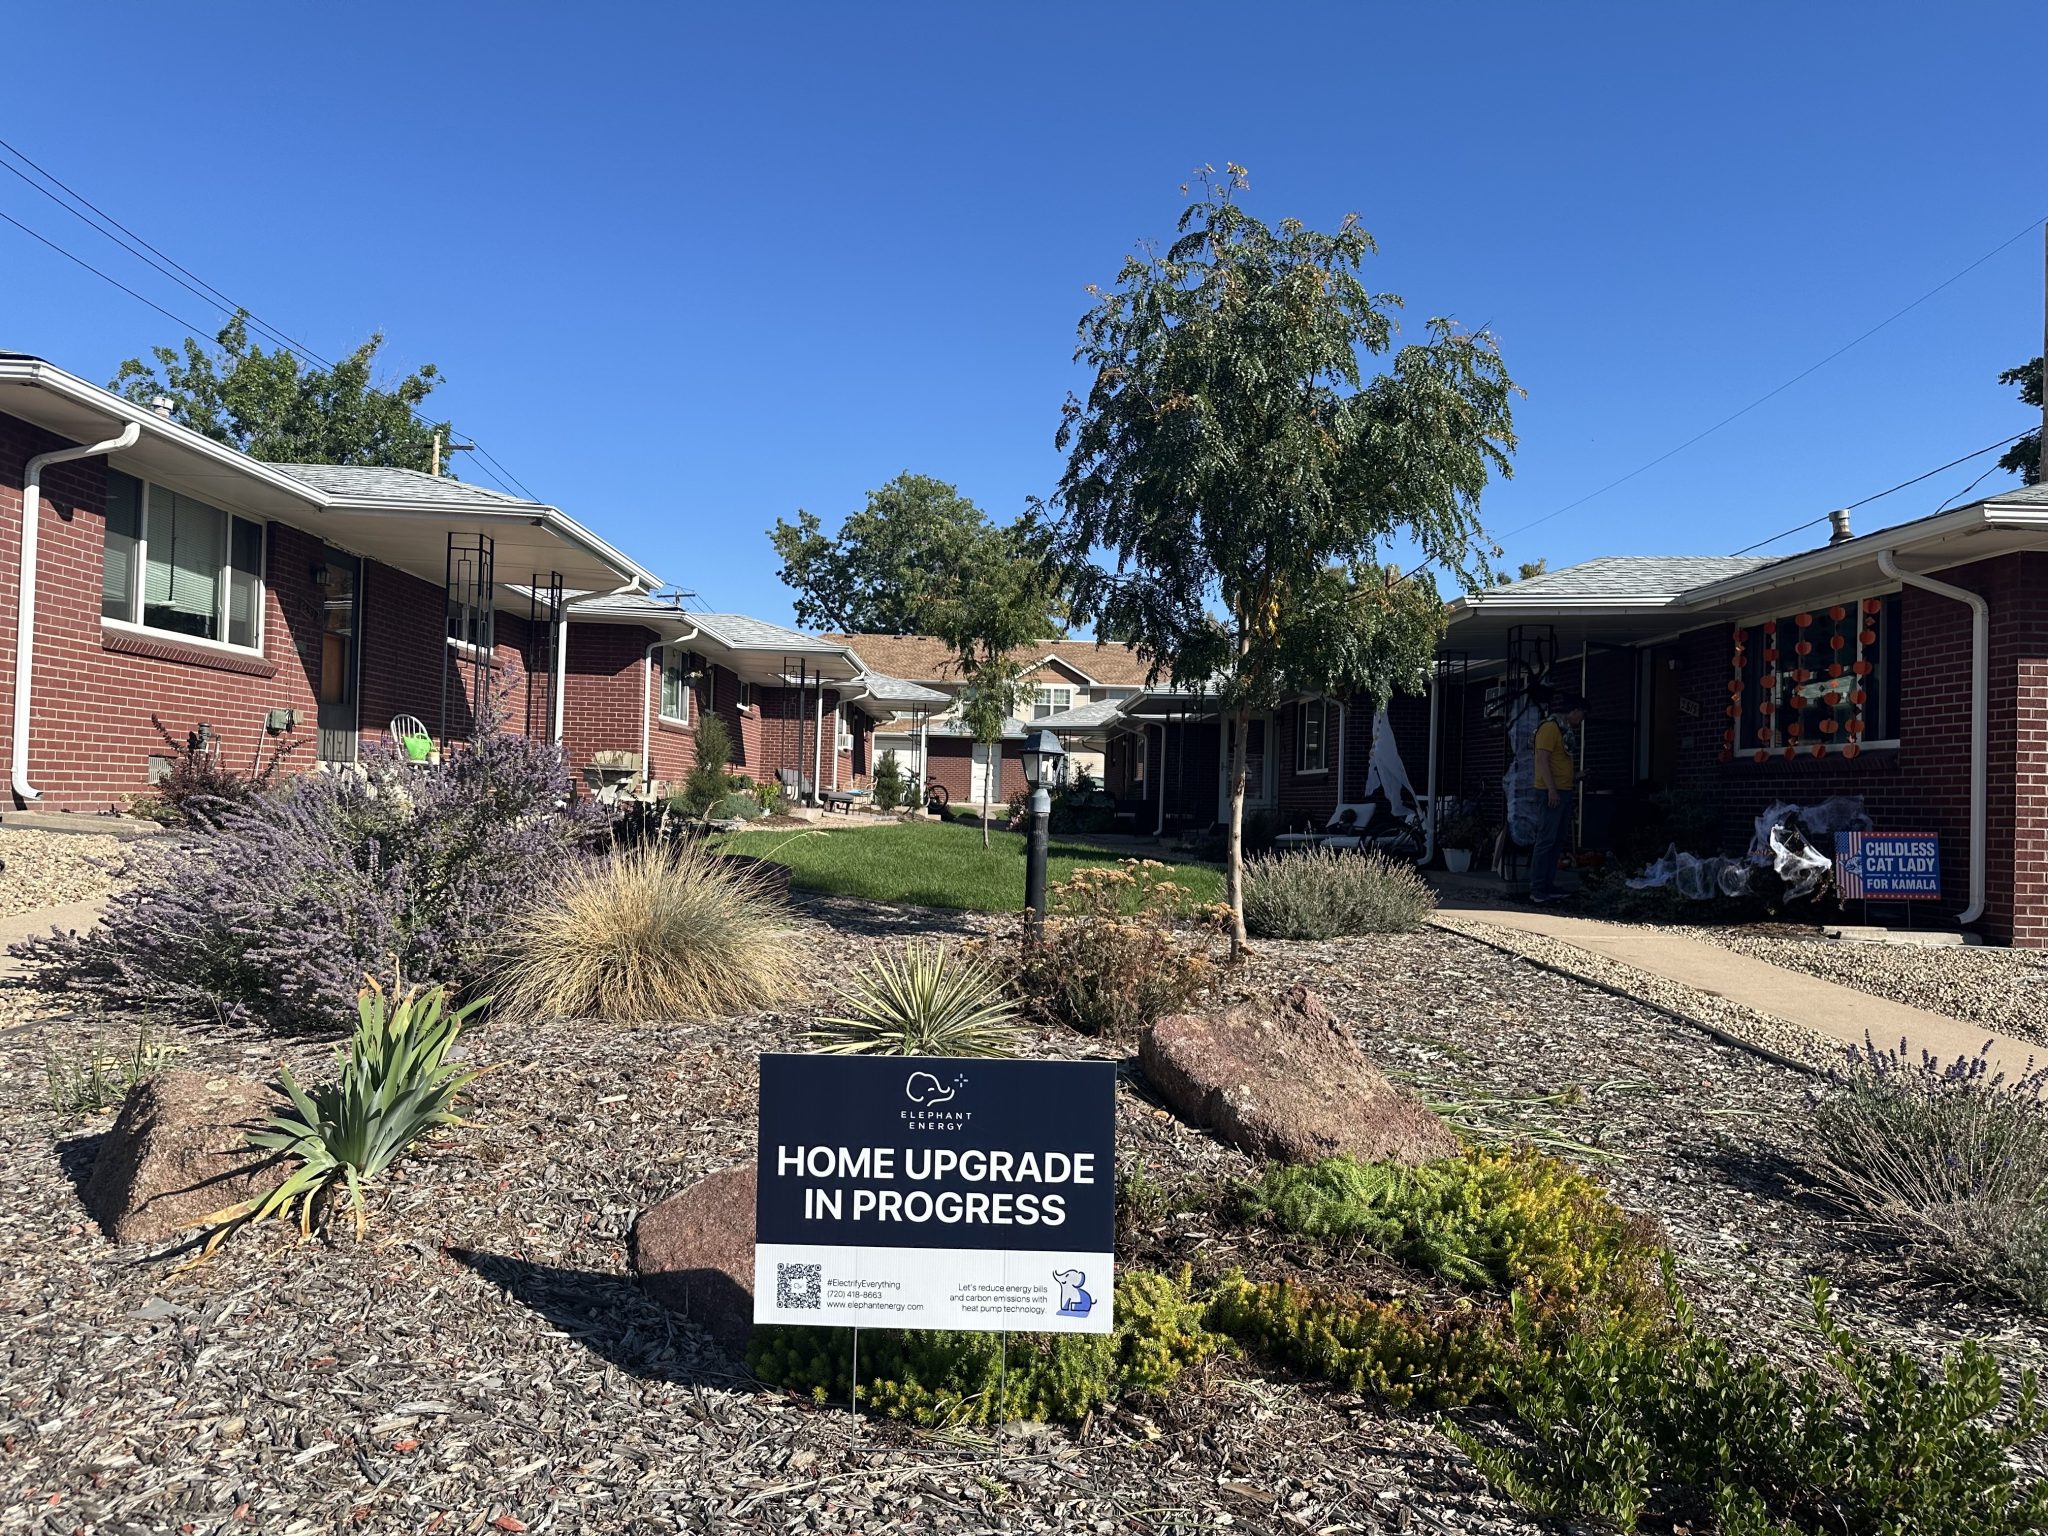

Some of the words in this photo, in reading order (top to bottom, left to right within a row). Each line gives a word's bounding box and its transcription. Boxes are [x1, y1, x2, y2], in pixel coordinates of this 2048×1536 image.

[1865, 842, 1935, 856] CHILDLESS
[1866, 858, 1893, 872] CAT
[1899, 858, 1935, 872] LADY
[1867, 879, 1888, 889] FOR
[1892, 879, 1936, 890] KAMALA
[900, 1110, 973, 1120] ELEPHANT
[908, 1121, 965, 1131] ENERGY
[777, 1145, 895, 1179] HOME
[905, 1148, 1095, 1184] UPGRADE
[804, 1188, 842, 1220] IN
[853, 1189, 1067, 1226] PROGRESS
[827, 1278, 901, 1290] #ElectrifyEverything
[958, 1283, 977, 1291] Let's
[978, 1284, 1004, 1292] reduce
[1005, 1285, 1031, 1294] energy
[1033, 1285, 1048, 1293] bills
[827, 1290, 846, 1299] (720)
[847, 1291, 882, 1299] 418-8663
[949, 1294, 964, 1302] and
[965, 1294, 992, 1302] carbon
[993, 1295, 1031, 1303] emissions
[827, 1300, 924, 1312] www.elephantenergy.com
[980, 1306, 1002, 1314] pump
